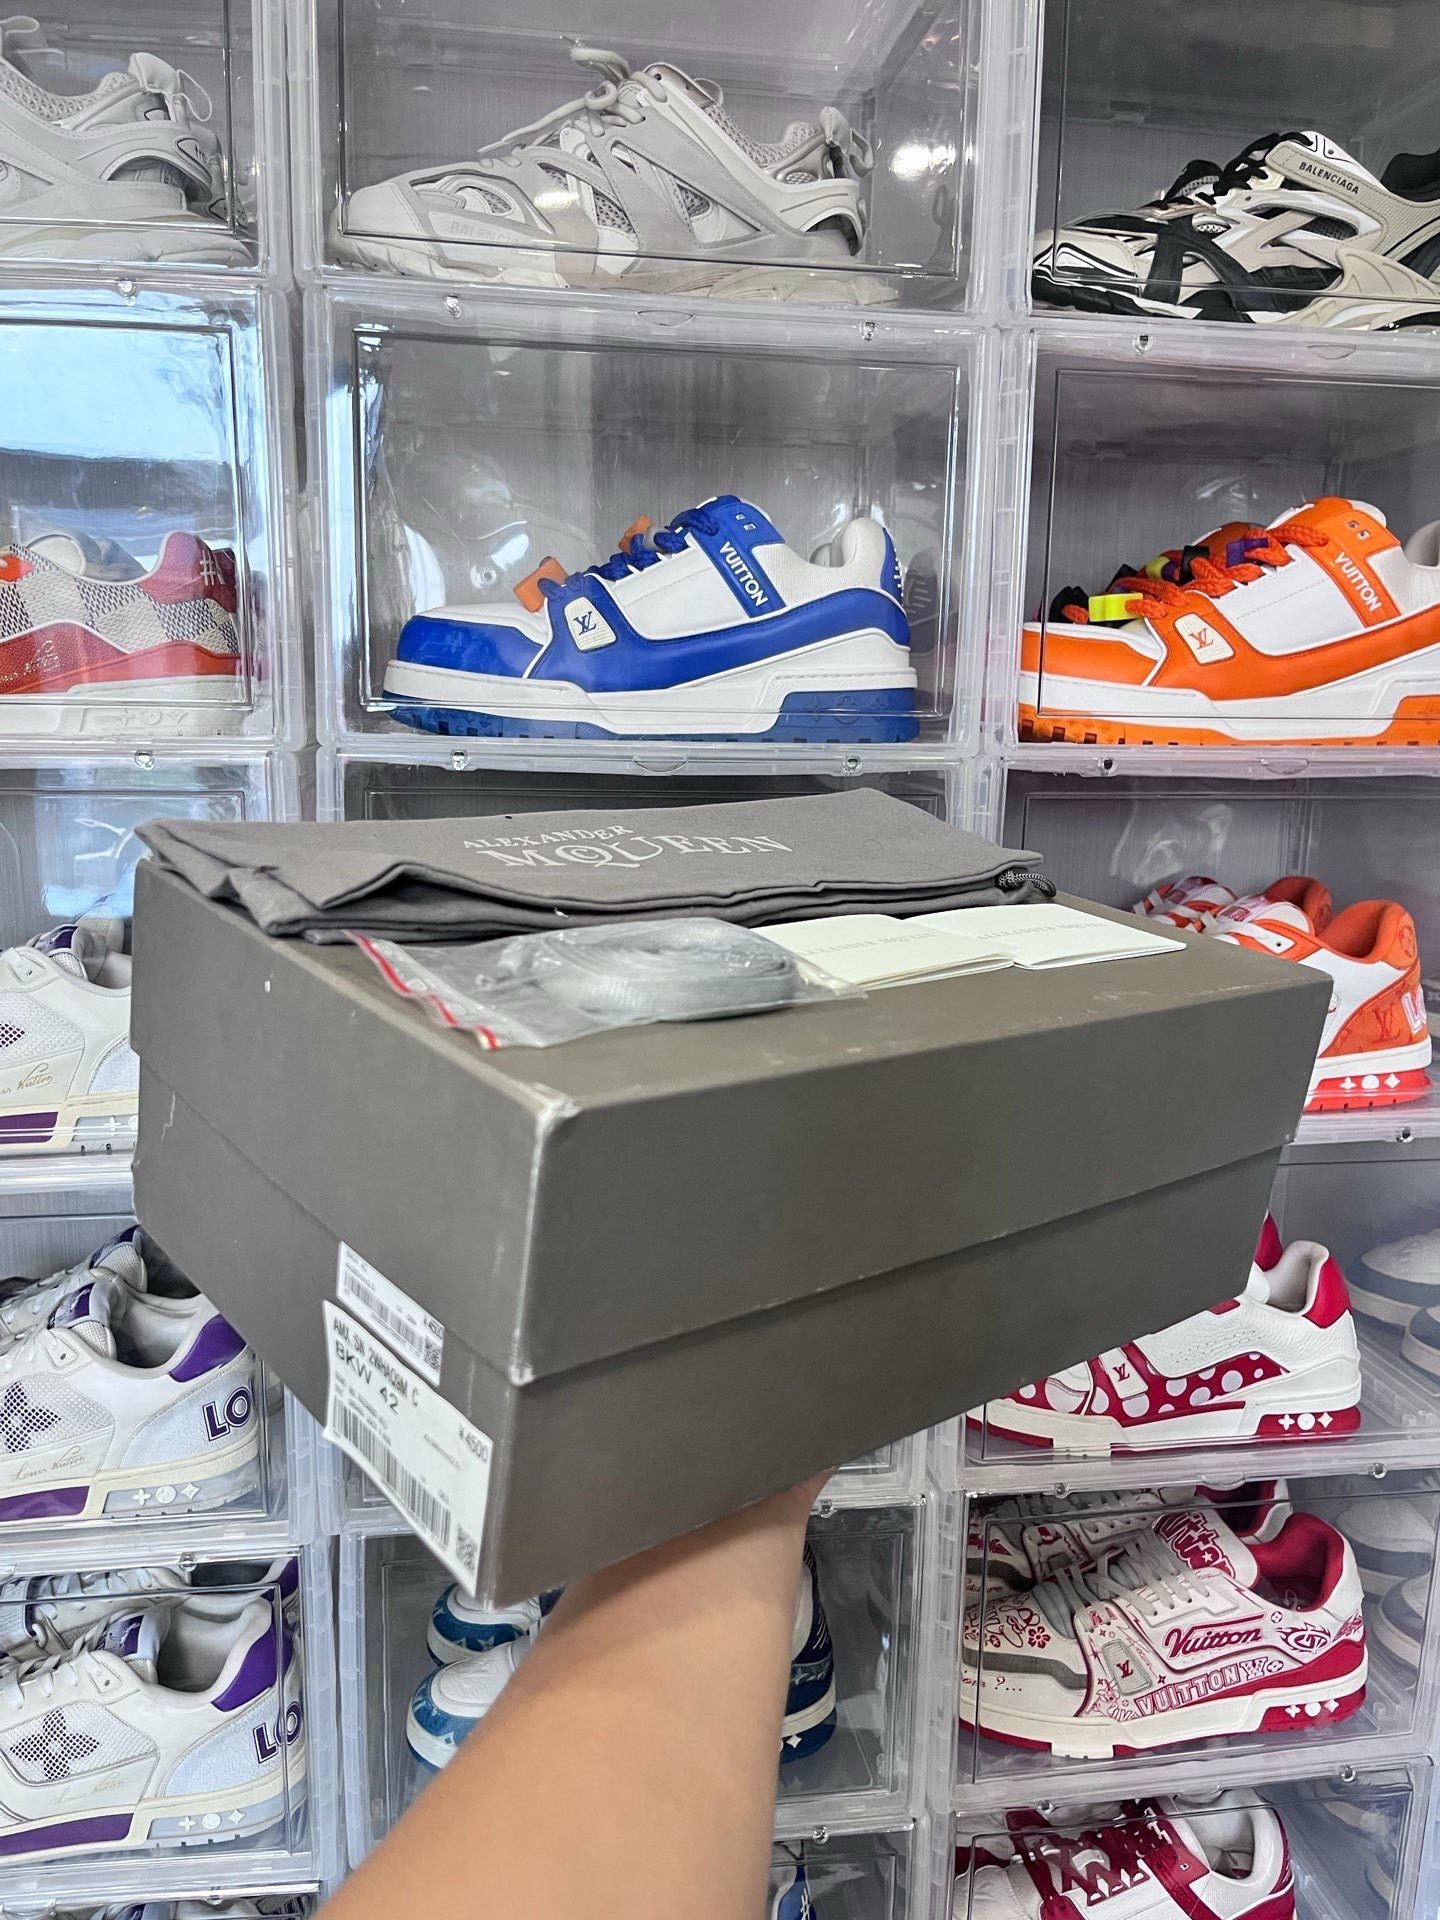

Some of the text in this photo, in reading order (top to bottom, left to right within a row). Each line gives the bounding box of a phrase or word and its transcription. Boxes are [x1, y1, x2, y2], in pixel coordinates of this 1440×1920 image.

[1299, 162, 1360, 195] BALENCIAGA
[719, 541, 769, 608] VUITTON
[1334, 551, 1383, 612] VUITTON
[463, 824, 635, 850] ALEXANDER
[336, 1338, 373, 1385] BKW
[380, 1386, 399, 1415] 42
[412, 1387, 419, 1408] C
[1163, 1613, 1266, 1660] Vuitton
[1135, 1664, 1241, 1717] VUITTON
